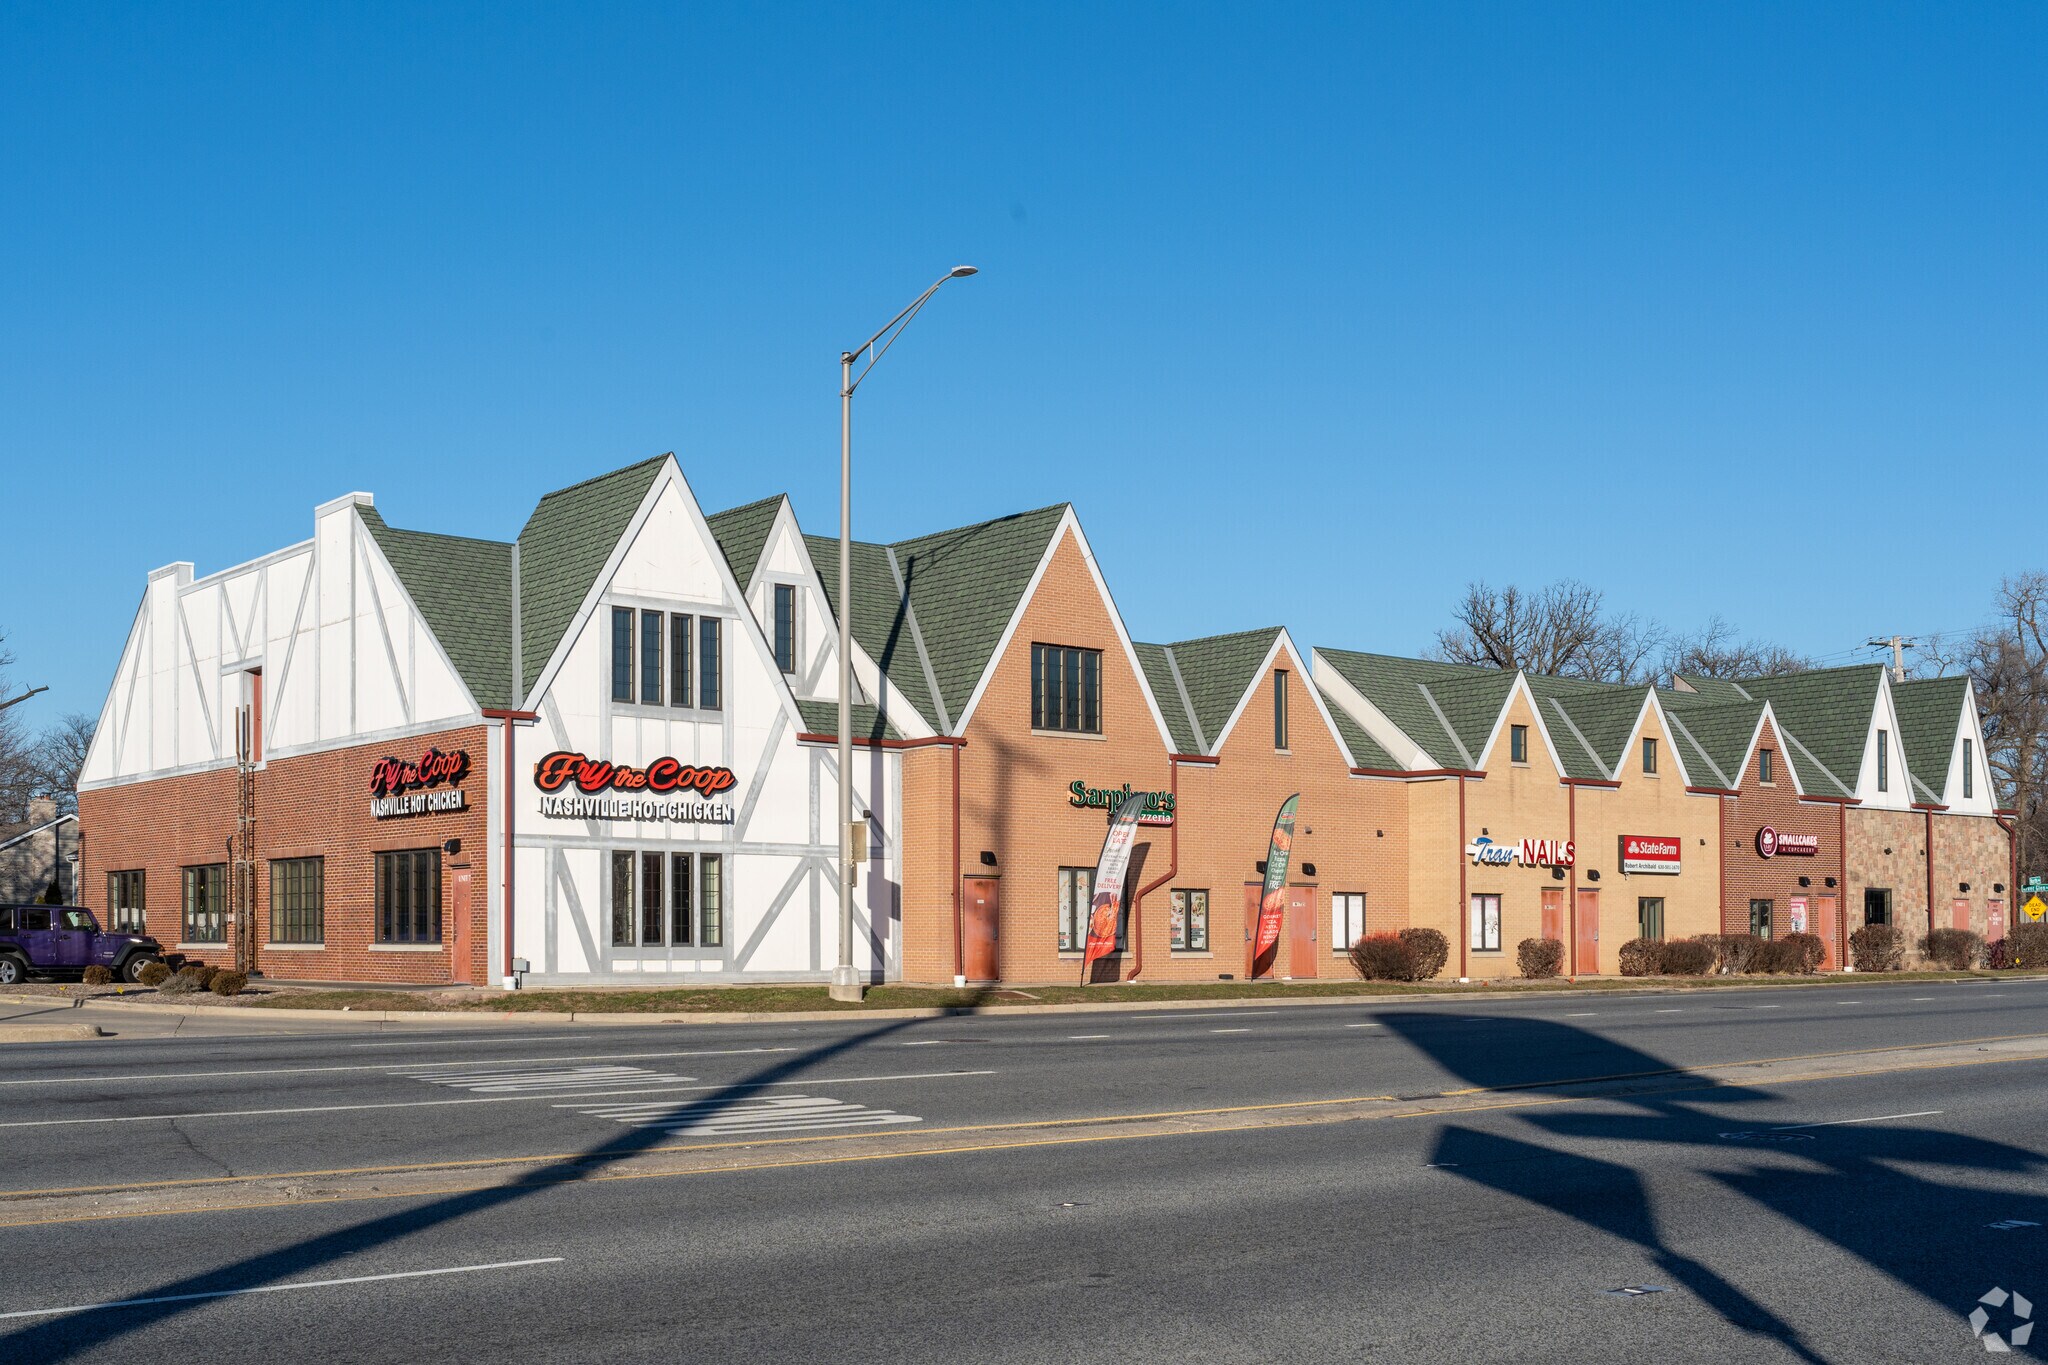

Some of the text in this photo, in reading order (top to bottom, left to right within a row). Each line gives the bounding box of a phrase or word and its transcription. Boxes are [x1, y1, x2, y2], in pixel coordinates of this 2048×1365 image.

[369, 750, 463, 793] Fry the Coop
[539, 754, 735, 796] Fry the Coop
[370, 790, 462, 817] NASHVILLE HOT CHICKEN
[542, 798, 732, 821] NASHVILLE HOT CHICKEN
[1072, 780, 1176, 814] Sarpio's
[1138, 812, 1171, 822] zzeria
[1476, 837, 1576, 865] Tran NAILS
[1778, 834, 1818, 846] SMALLCAKES
